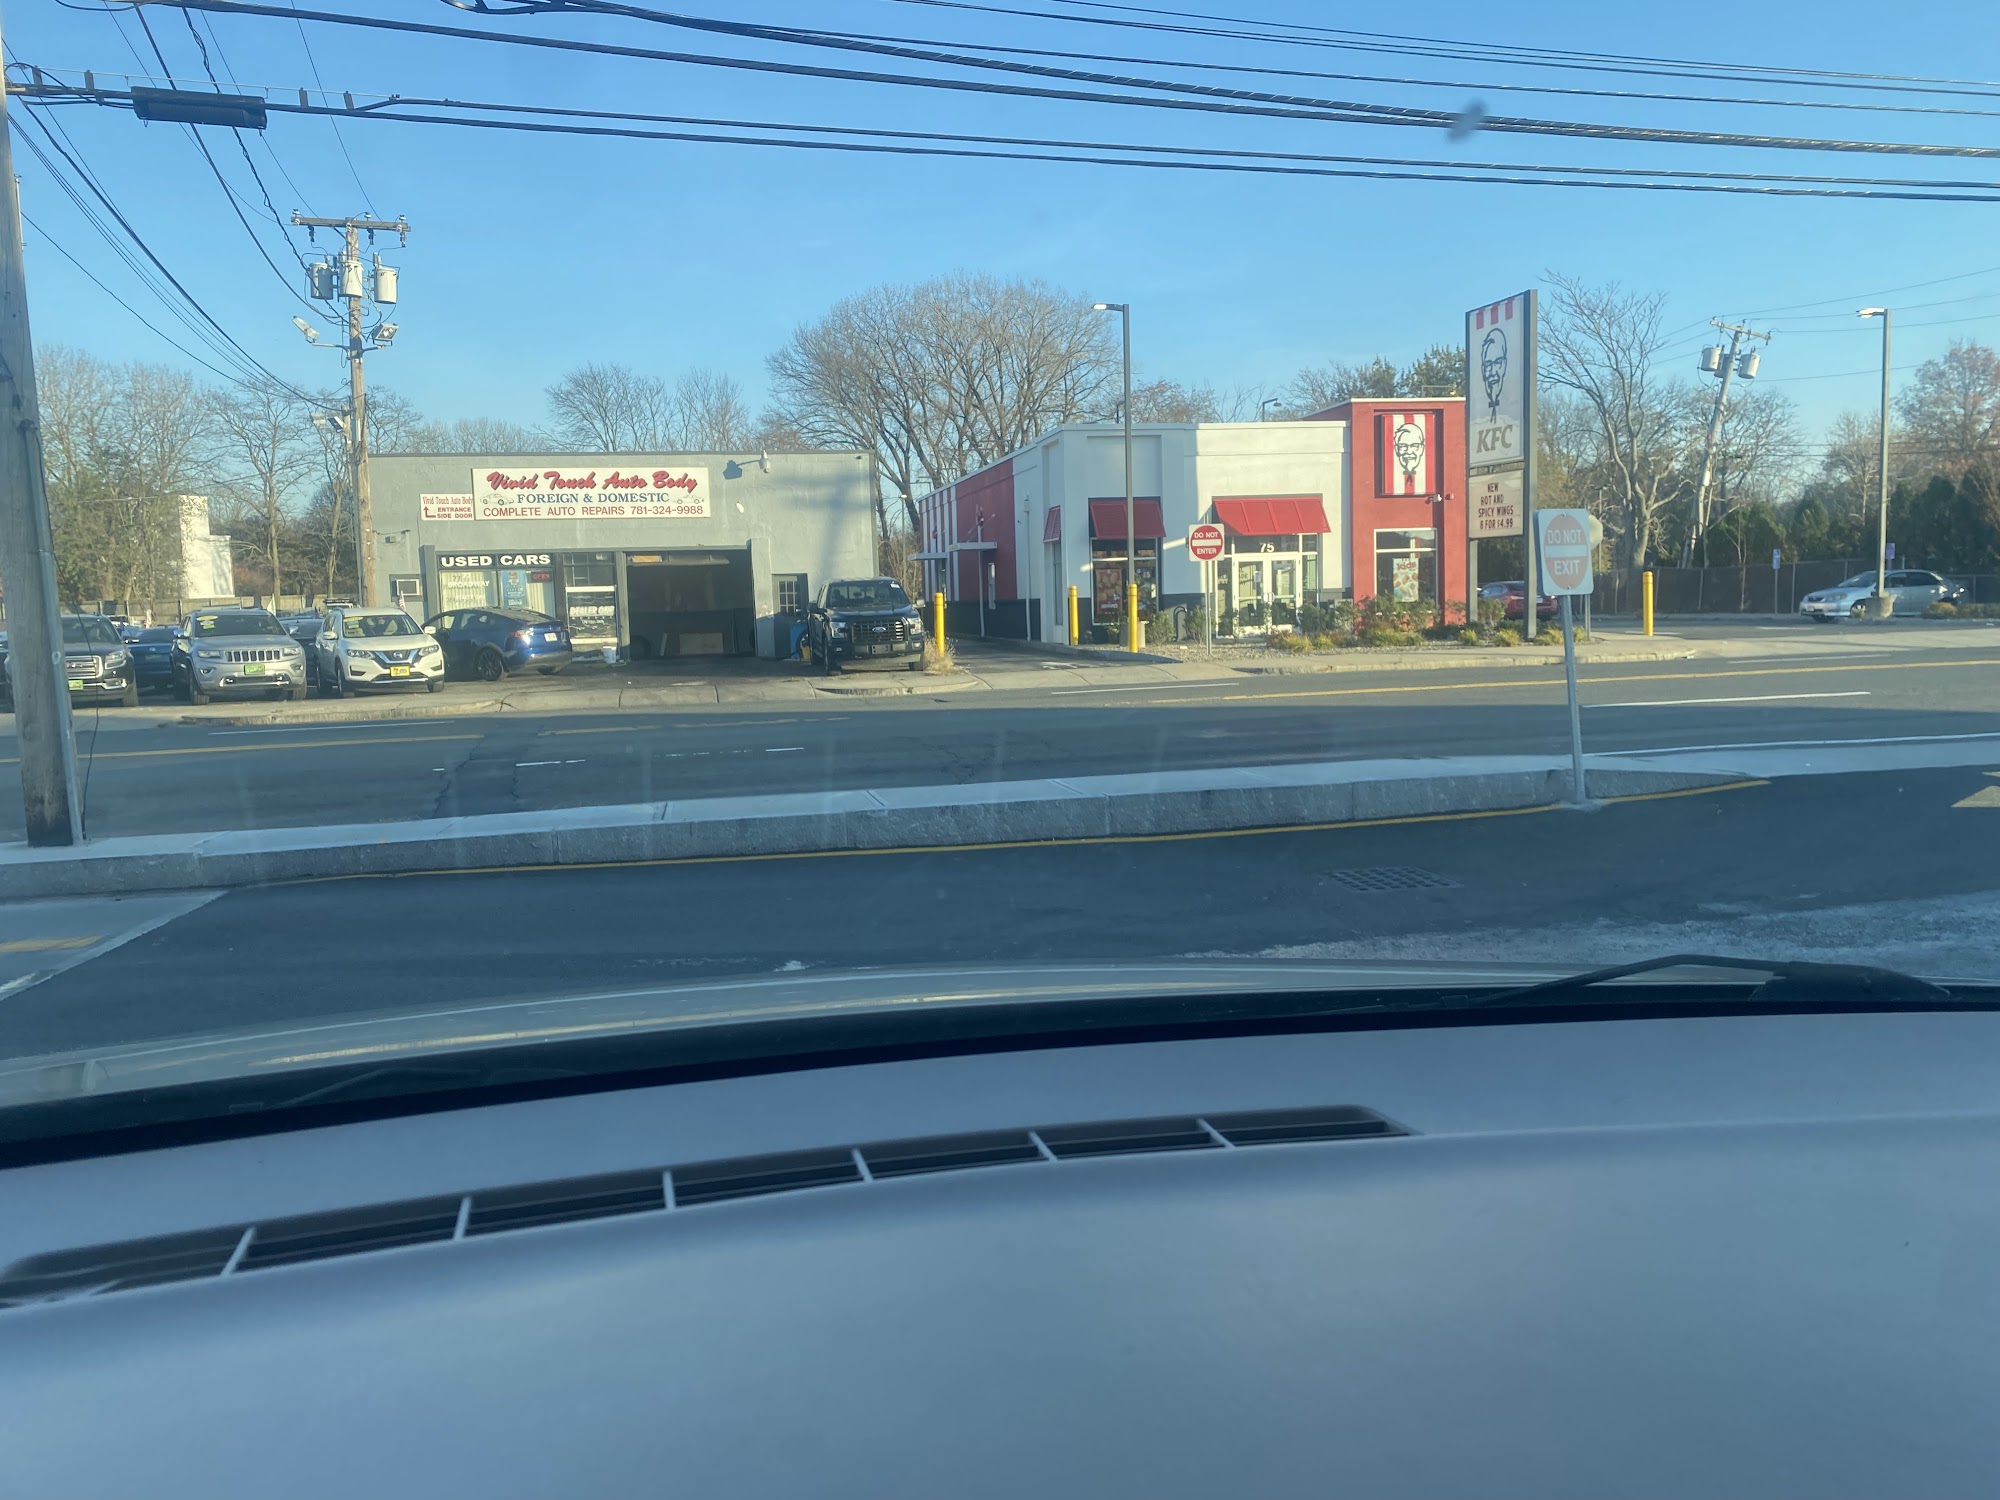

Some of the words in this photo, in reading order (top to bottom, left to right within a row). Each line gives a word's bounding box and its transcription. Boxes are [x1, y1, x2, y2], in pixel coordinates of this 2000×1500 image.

[1476, 424, 1513, 454] KFC
[486, 471, 539, 490] Vivid
[543, 471, 597, 490] Touch
[602, 471, 648, 490] Auto
[652, 470, 698, 494] Body
[1487, 482, 1499, 493] NEW
[422, 496, 434, 505] Vivid
[435, 496, 449, 505] Touch
[450, 496, 461, 505] Auto
[462, 496, 473, 506] Body
[516, 493, 579, 504] FOREIGN
[583, 493, 594, 503] &
[598, 492, 670, 503] DOMESTIC
[1480, 495, 1492, 506] HOT
[1493, 494, 1504, 504] AND
[483, 507, 542, 517] COMPLETE
[547, 506, 576, 516] AUTO
[581, 506, 625, 516] REPAIRS
[630, 505, 704, 515] 781-324-9988
[1478, 506, 1495, 518] SPICY
[1496, 505, 1514, 516] WINGS
[1479, 520, 1484, 530] 8
[1485, 519, 1496, 530] FOR
[1497, 518, 1514, 528] $4.99
[1547, 530, 1561, 544] DO
[1562, 529, 1582, 544] NOT
[1196, 547, 1217, 555] ENTER
[1260, 543, 1275, 553] 75
[441, 555, 493, 567] USED
[500, 554, 551, 565] CARS
[1553, 559, 1581, 576] EXIT
[448, 580, 490, 588] BROADWAY
